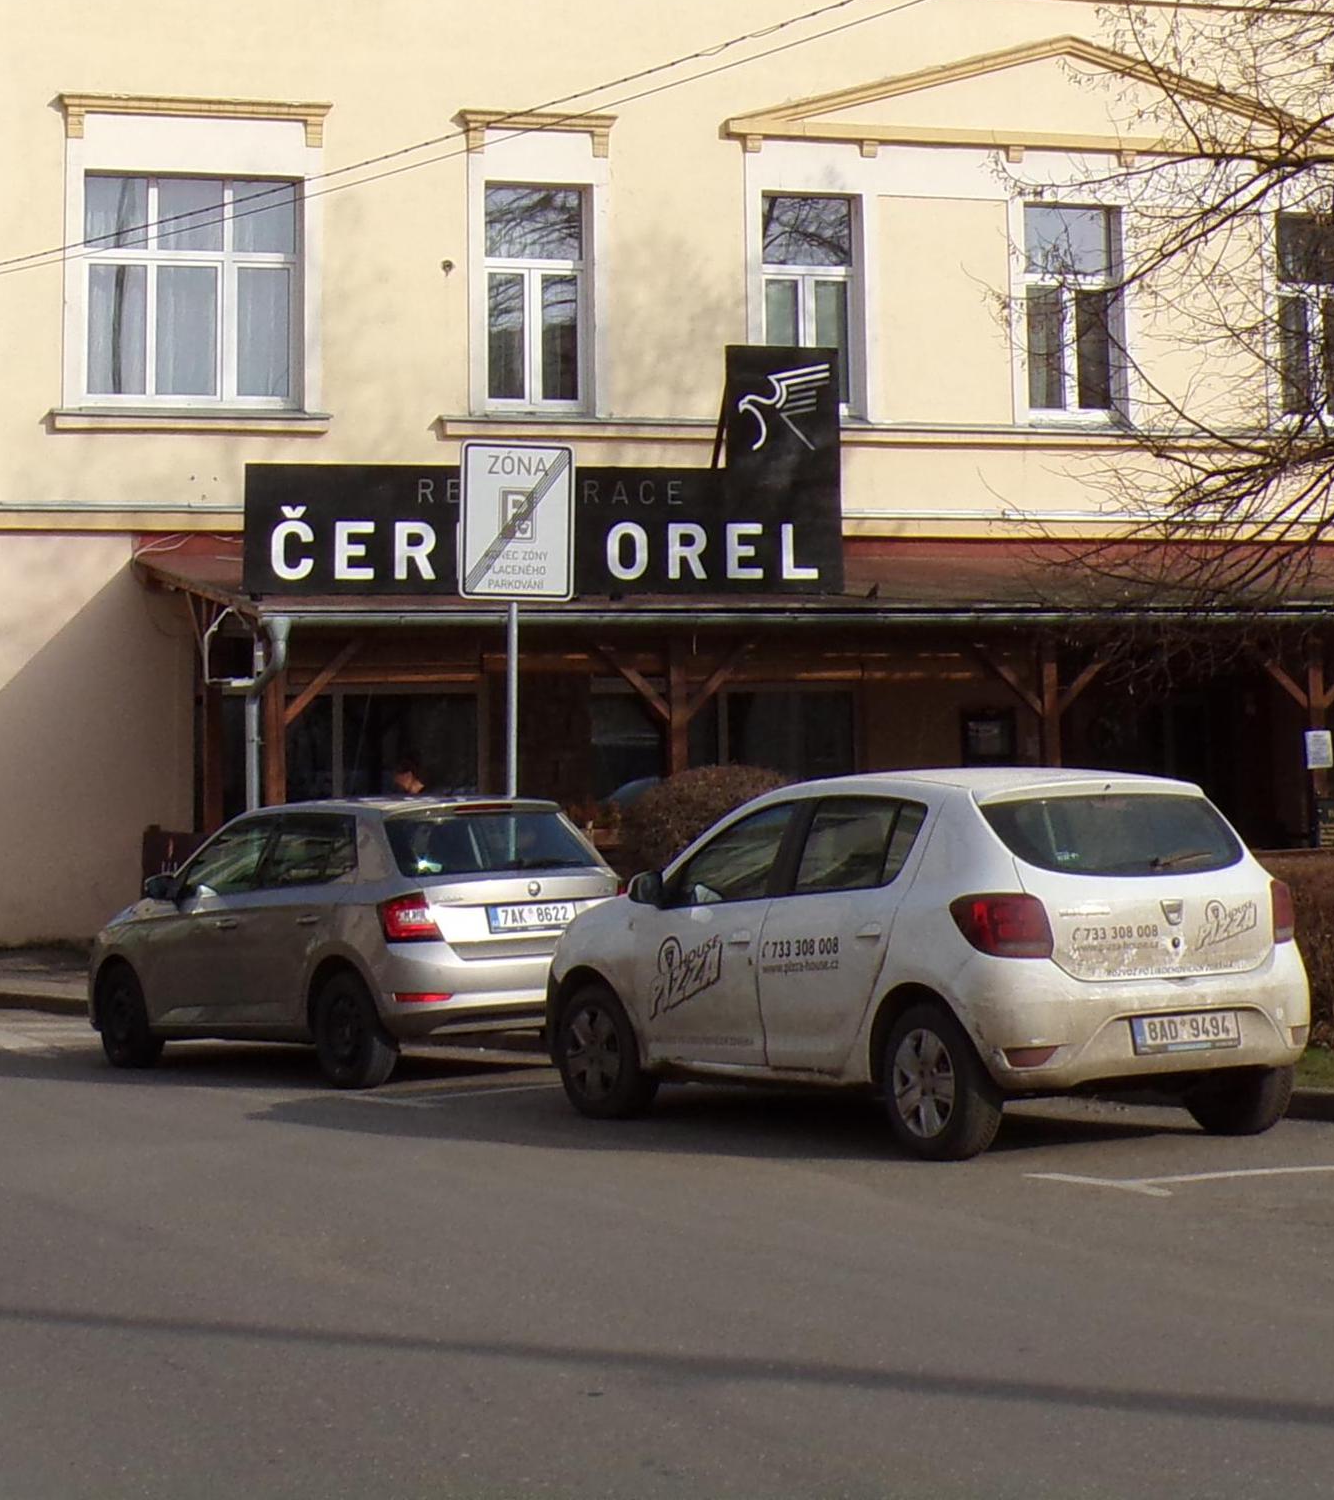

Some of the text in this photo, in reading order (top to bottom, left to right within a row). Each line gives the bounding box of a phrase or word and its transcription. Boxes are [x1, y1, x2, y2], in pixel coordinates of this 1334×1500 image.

[487, 451, 549, 477] ZÓNA
[417, 478, 683, 506] RERACE
[269, 505, 820, 581] ČER OREL
[487, 548, 549, 562] NEC ZÓNY
[487, 563, 547, 576] LACENÉHO
[487, 577, 545, 590] PARKOVÁNÍ
[501, 905, 570, 926] 7AK 8622
[1083, 924, 1159, 941] 733 308 008
[771, 935, 840, 958] 733 308 008
[1147, 1014, 1231, 1042] 8AD 9494
